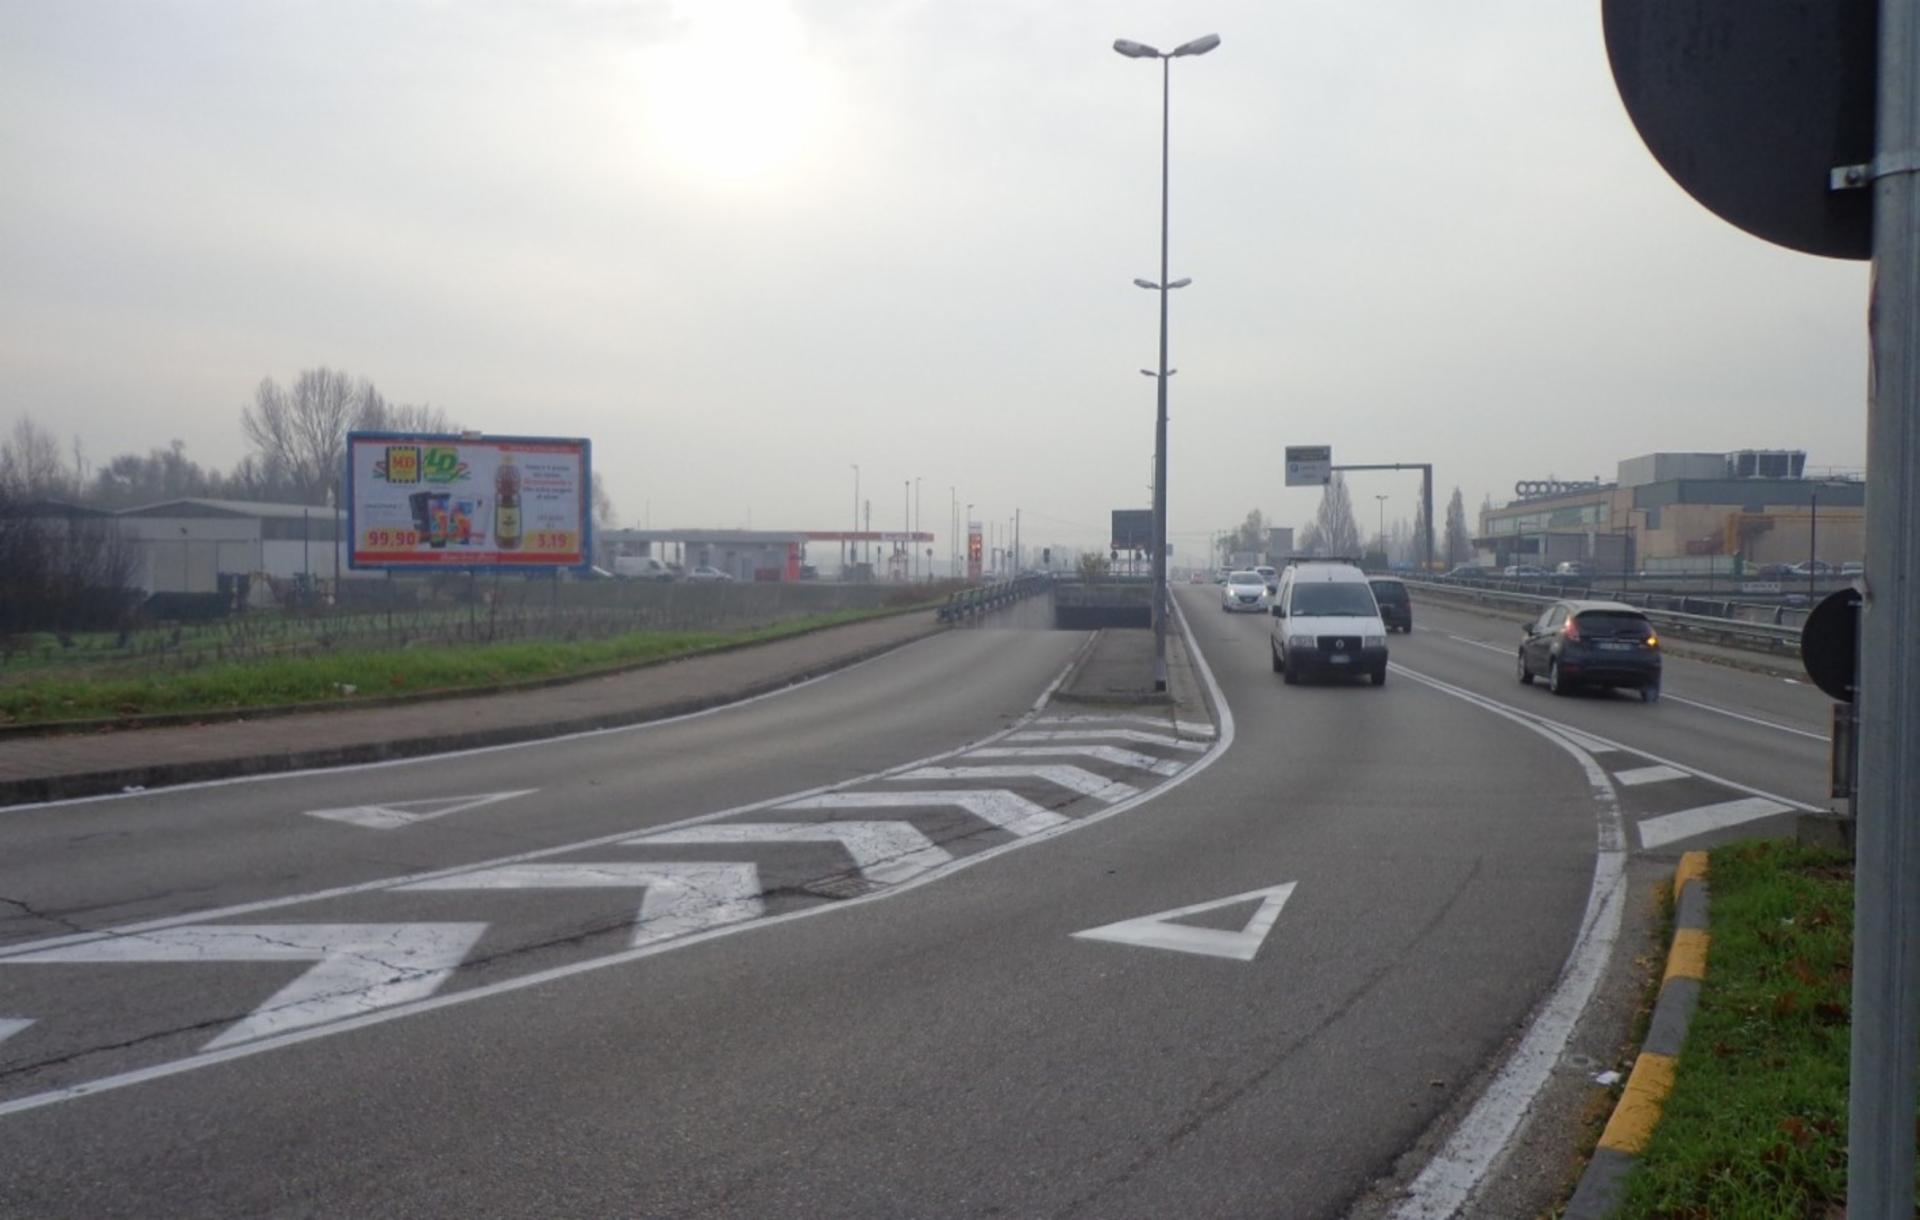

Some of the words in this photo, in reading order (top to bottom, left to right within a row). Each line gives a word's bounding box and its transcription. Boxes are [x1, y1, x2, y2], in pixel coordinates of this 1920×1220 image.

[392, 455, 416, 469] MD
[425, 447, 458, 470] LD
[368, 530, 416, 546] 99,90
